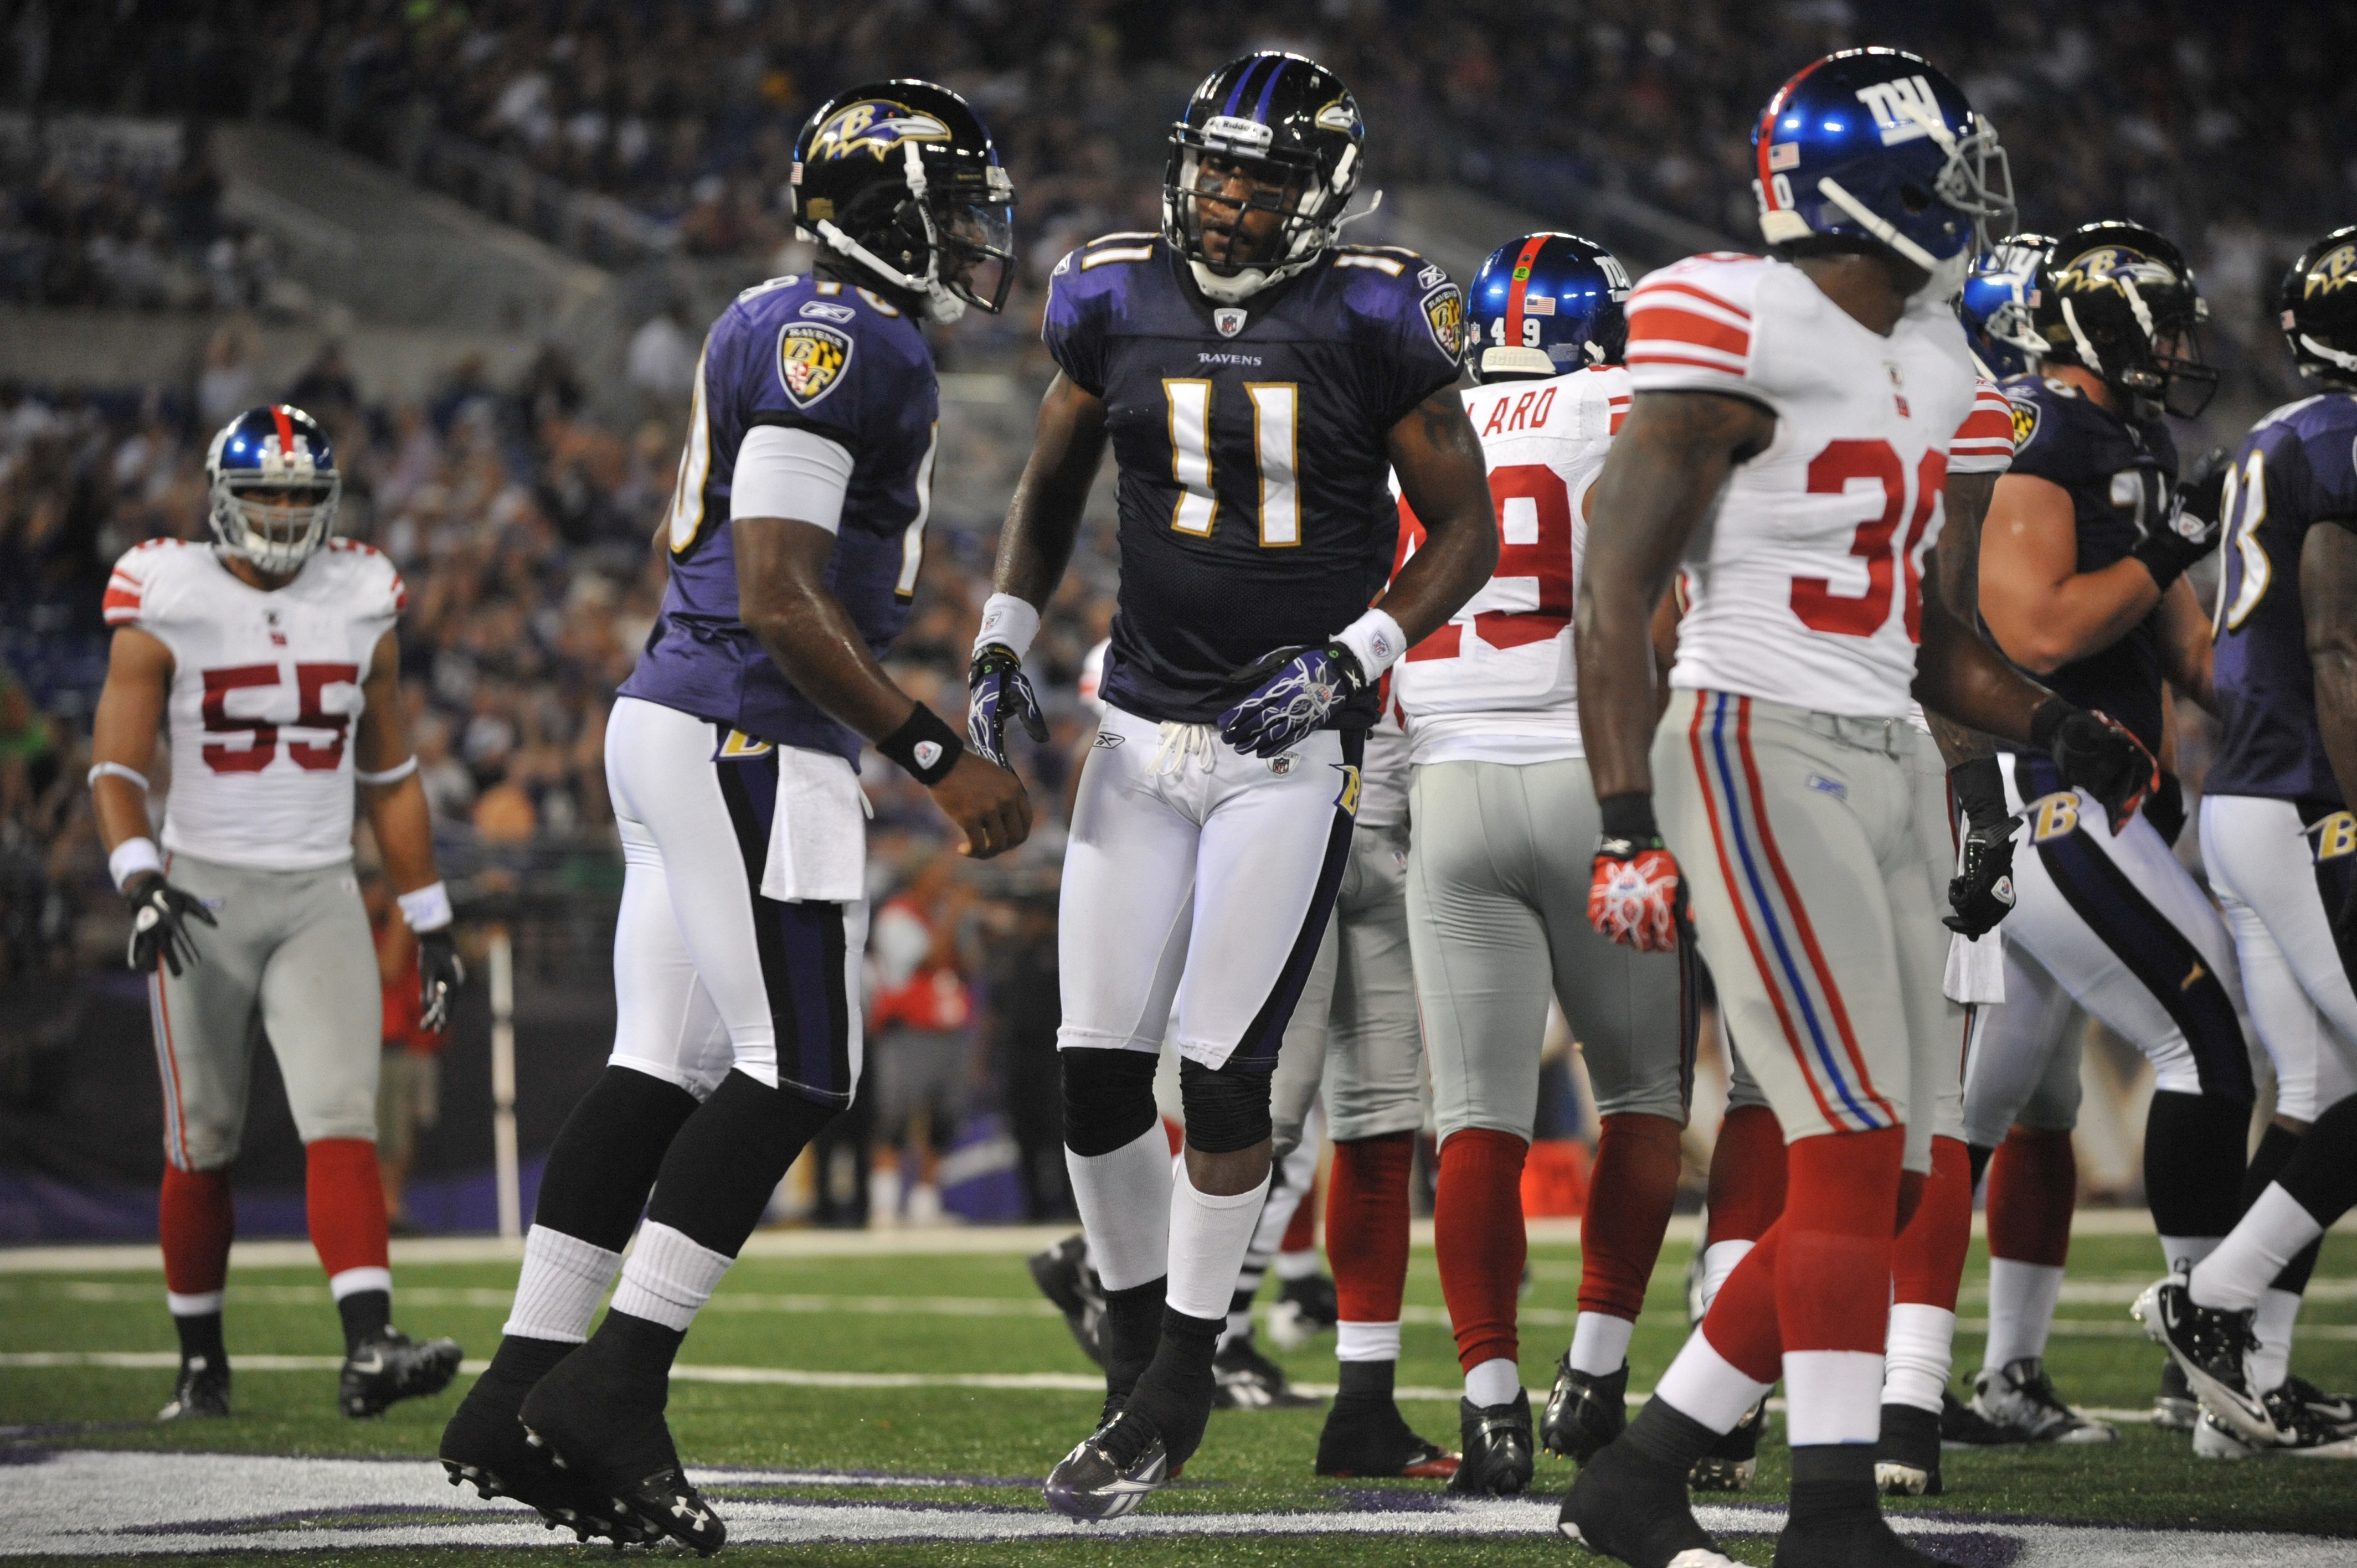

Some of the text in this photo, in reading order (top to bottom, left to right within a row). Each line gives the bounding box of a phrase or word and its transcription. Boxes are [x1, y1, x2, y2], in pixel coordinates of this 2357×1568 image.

[1522, 318, 1541, 347] 9
[1197, 353, 1262, 367] RAVENS
[1161, 378, 1301, 547] 11
[202, 662, 359, 773] 55
[1274, 764, 1288, 773] NFL
